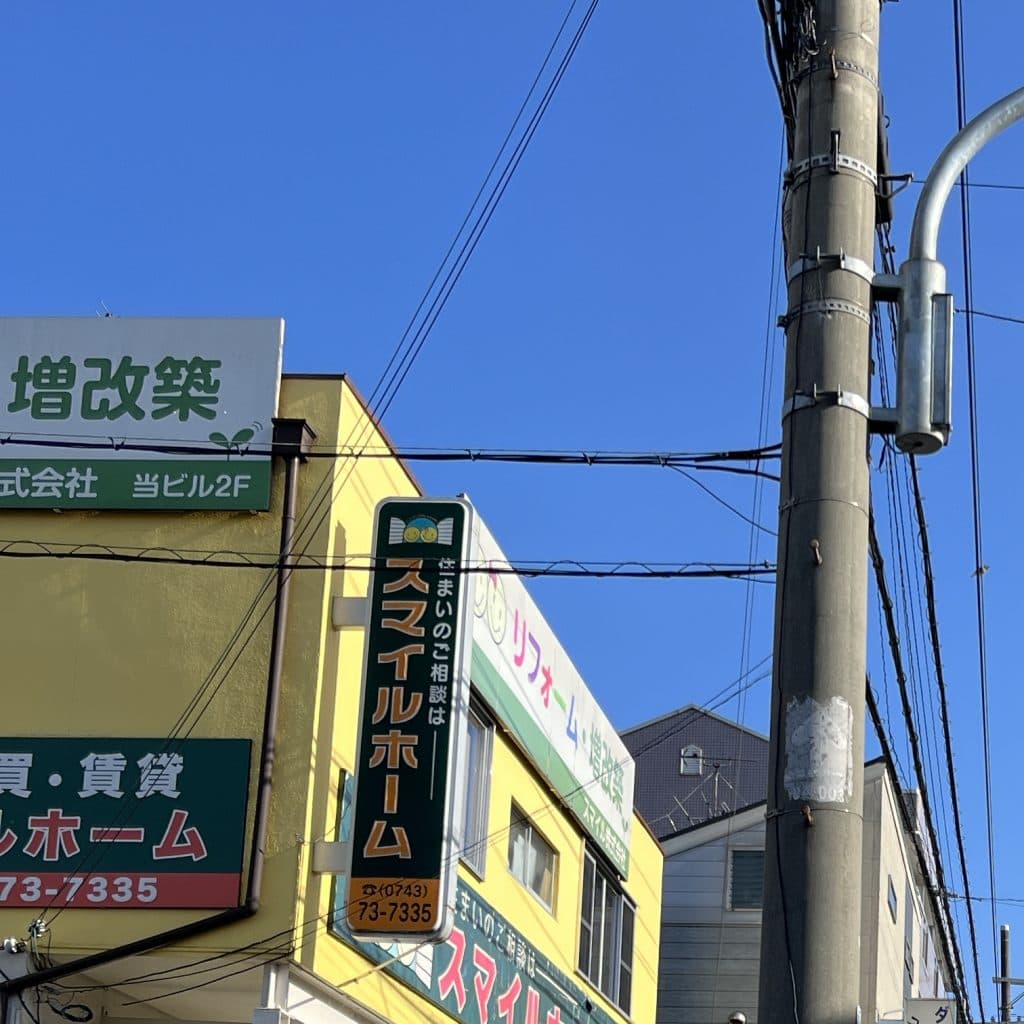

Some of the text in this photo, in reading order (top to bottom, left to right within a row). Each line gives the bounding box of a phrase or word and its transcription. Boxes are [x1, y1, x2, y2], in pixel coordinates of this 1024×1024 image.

[8, 355, 222, 421] 増改築
[0, 467, 251, 499] 式会社 当ビル2F
[427, 557, 457, 727] 住まいのご相談は
[363, 556, 430, 860] スマイルホーム
[0, 876, 158, 903] 73-7335
[358, 901, 432, 923] 73-7335
[455, 888, 536, 978] まいのご相談は
